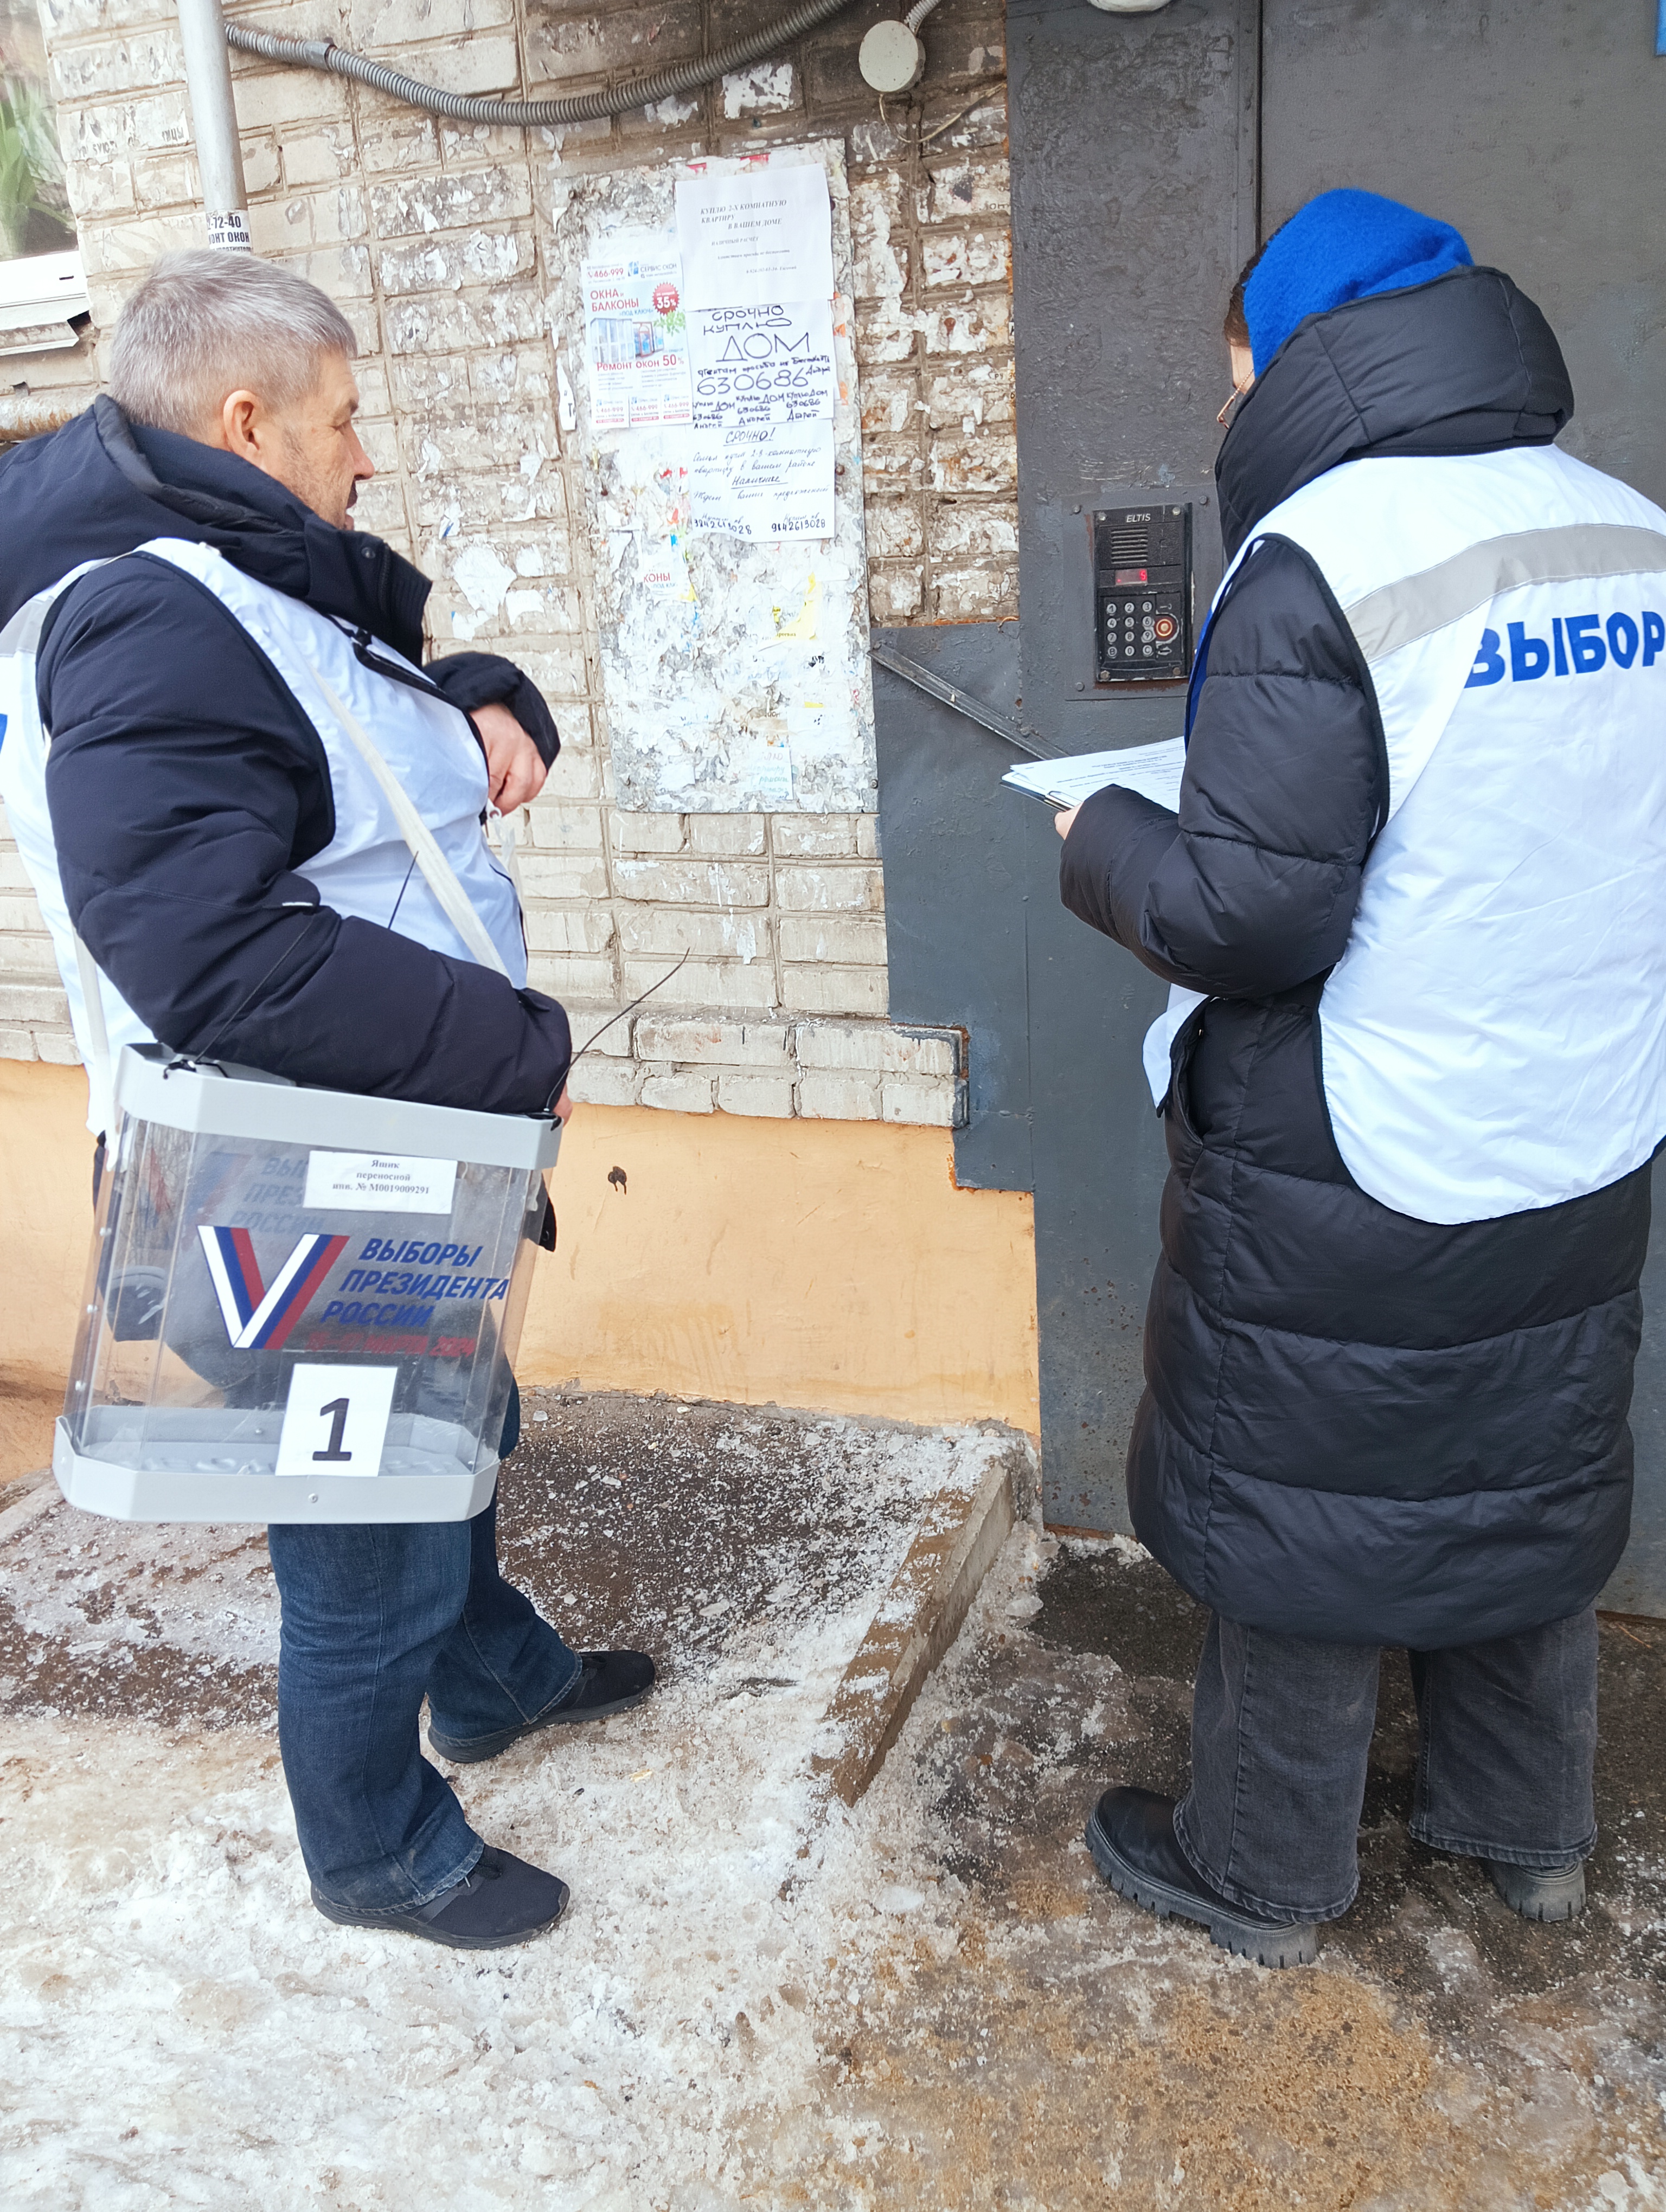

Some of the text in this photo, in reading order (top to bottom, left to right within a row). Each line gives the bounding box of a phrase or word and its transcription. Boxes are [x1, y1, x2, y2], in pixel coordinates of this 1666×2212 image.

[701, 207, 726, 215] КУПЛЮ
[740, 200, 787, 210] КОМНАТНУЮ
[701, 214, 735, 223] КВАРТИРУ
[734, 221, 760, 229] ВАШЕМ
[762, 218, 782, 227] ДОМЕ
[227, 232, 249, 242] ОКОН
[594, 268, 624, 278] 466-999
[591, 288, 618, 300] ОКНА
[592, 298, 639, 312] БАЛКОНЫ
[657, 297, 676, 309] 35%
[712, 305, 784, 322] СРОЧНО
[703, 318, 792, 336] КУПЛЮ
[715, 332, 810, 363] ДОМ
[697, 367, 808, 396] 630686
[758, 393, 785, 404] ДОМ
[1126, 513, 1151, 523] ELTIS
[356, 1171, 410, 1182] переносной
[358, 1238, 483, 1267] ВЫБОРЫ
[338, 1269, 510, 1300] ПРЕЗИДЕНТА
[321, 1301, 435, 1328] РОССИИ
[312, 1398, 352, 1462] 1
